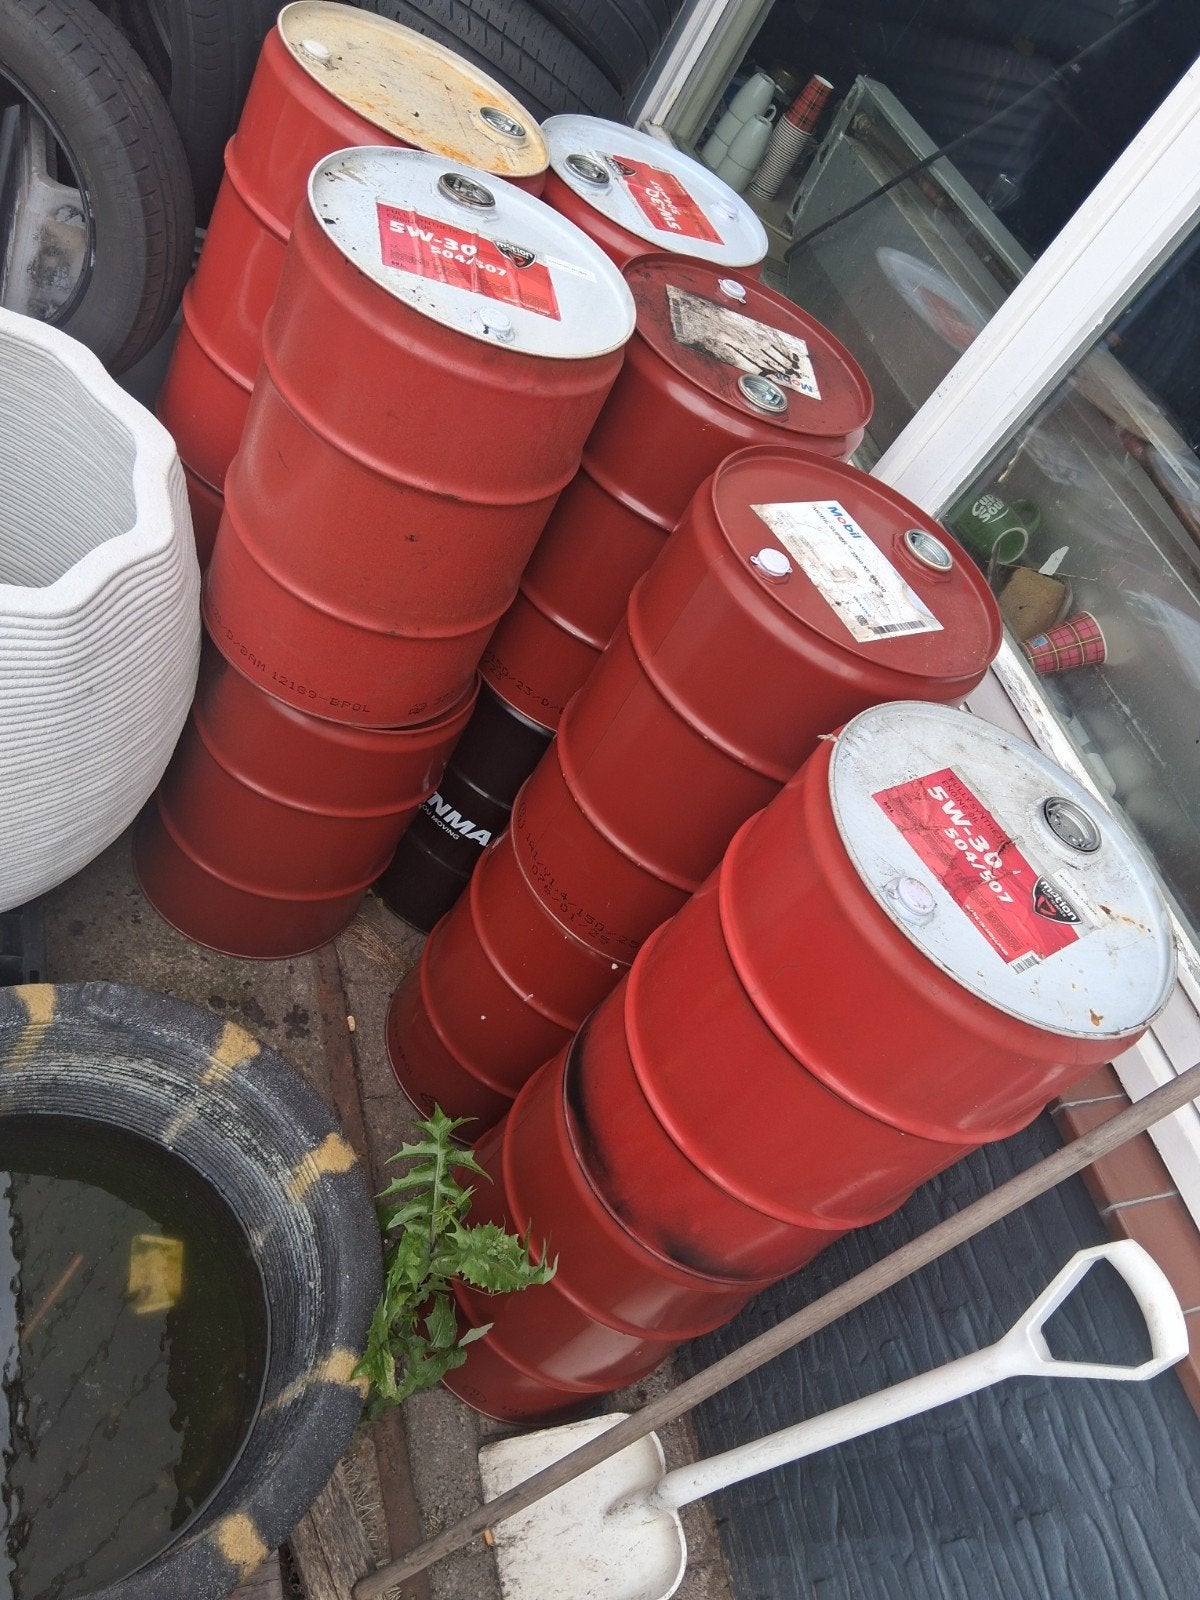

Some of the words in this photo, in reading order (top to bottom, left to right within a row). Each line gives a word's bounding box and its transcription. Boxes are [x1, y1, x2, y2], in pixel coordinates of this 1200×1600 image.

[389, 219, 478, 256] 5W-30
[430, 244, 507, 276] 504/507
[827, 506, 862, 539] Mobil
[430, 814, 460, 840] MOVING
[926, 785, 1003, 870] 5W-30
[943, 827, 1014, 903] 504/507
[1040, 880, 1078, 921] motion
